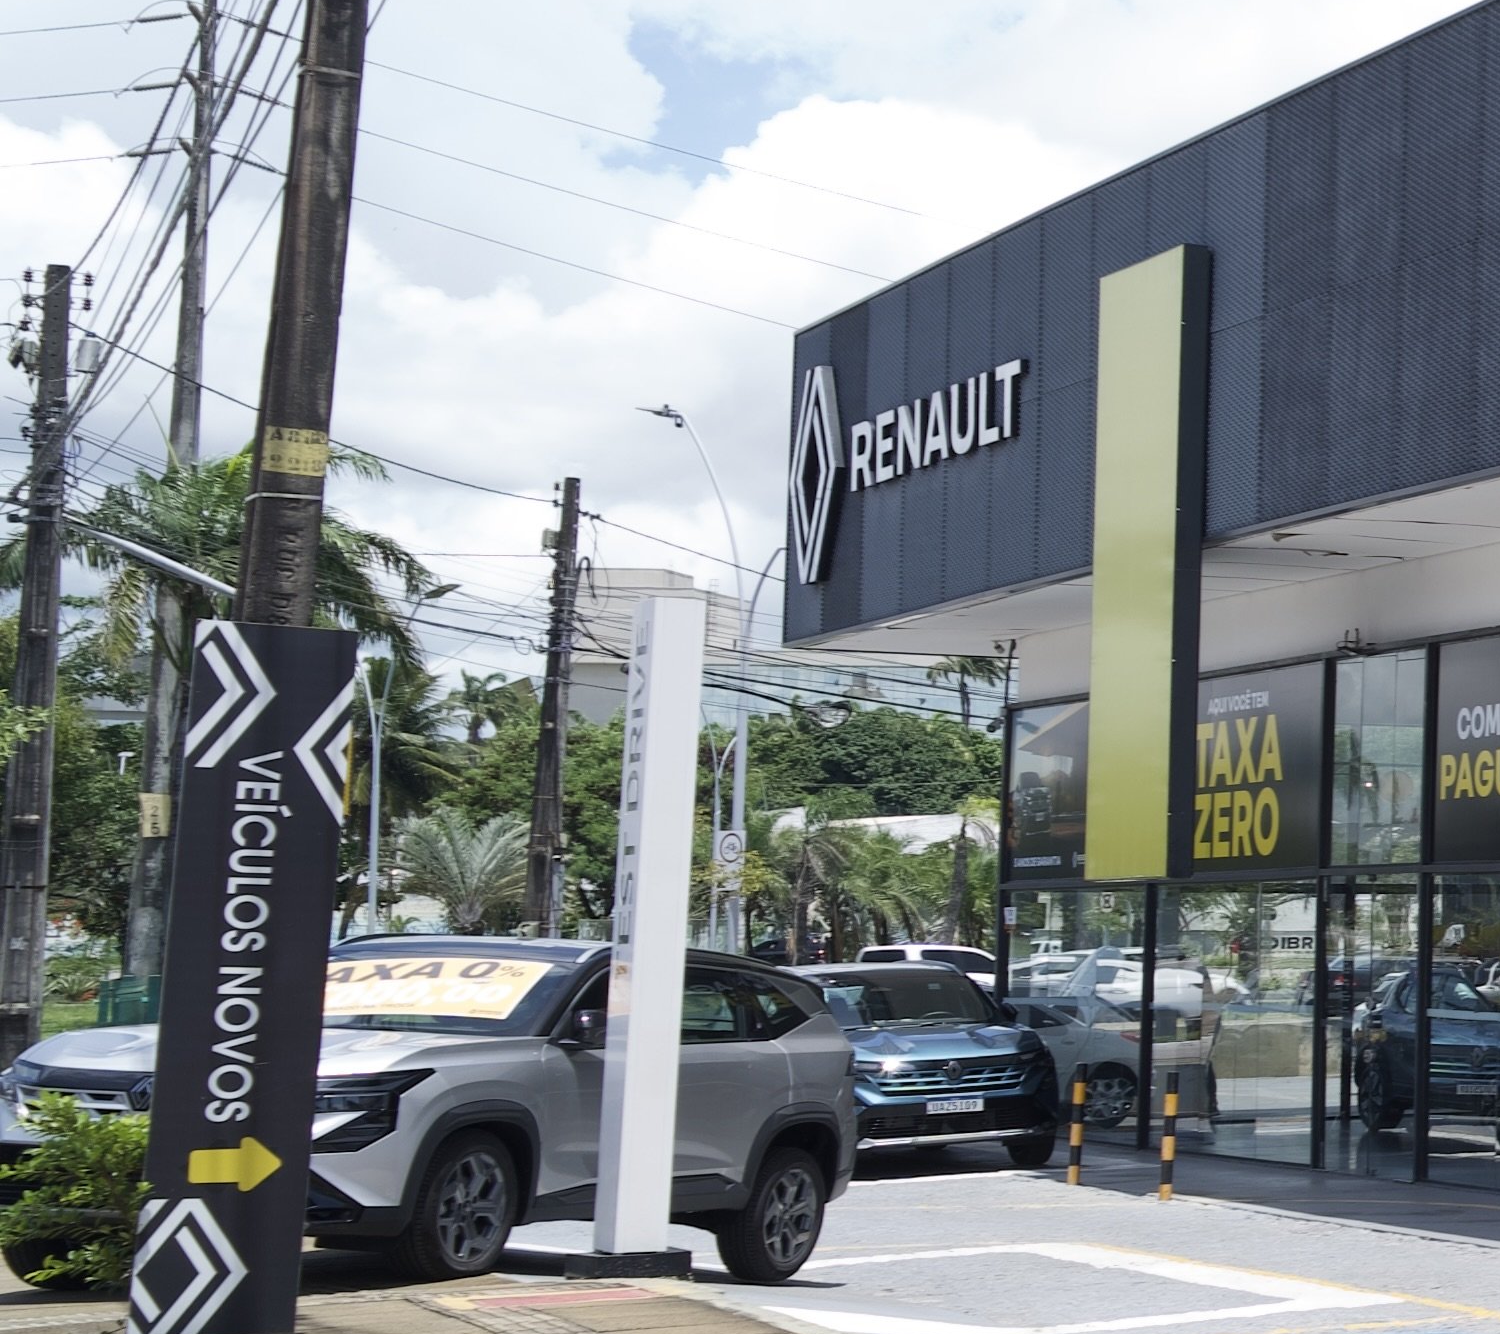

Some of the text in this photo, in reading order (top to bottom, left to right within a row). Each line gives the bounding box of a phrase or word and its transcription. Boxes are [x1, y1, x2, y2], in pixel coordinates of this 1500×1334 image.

[850, 359, 1022, 492] RENAULT
[626, 620, 650, 812] DRIVE
[1207, 689, 1270, 715] AQUI VOCÊ TEM
[1196, 714, 1283, 788] TAXA
[1194, 787, 1280, 859] ZERO
[204, 751, 291, 1125] VEÍCULOS NOVOS
[327, 961, 444, 984] AXA
